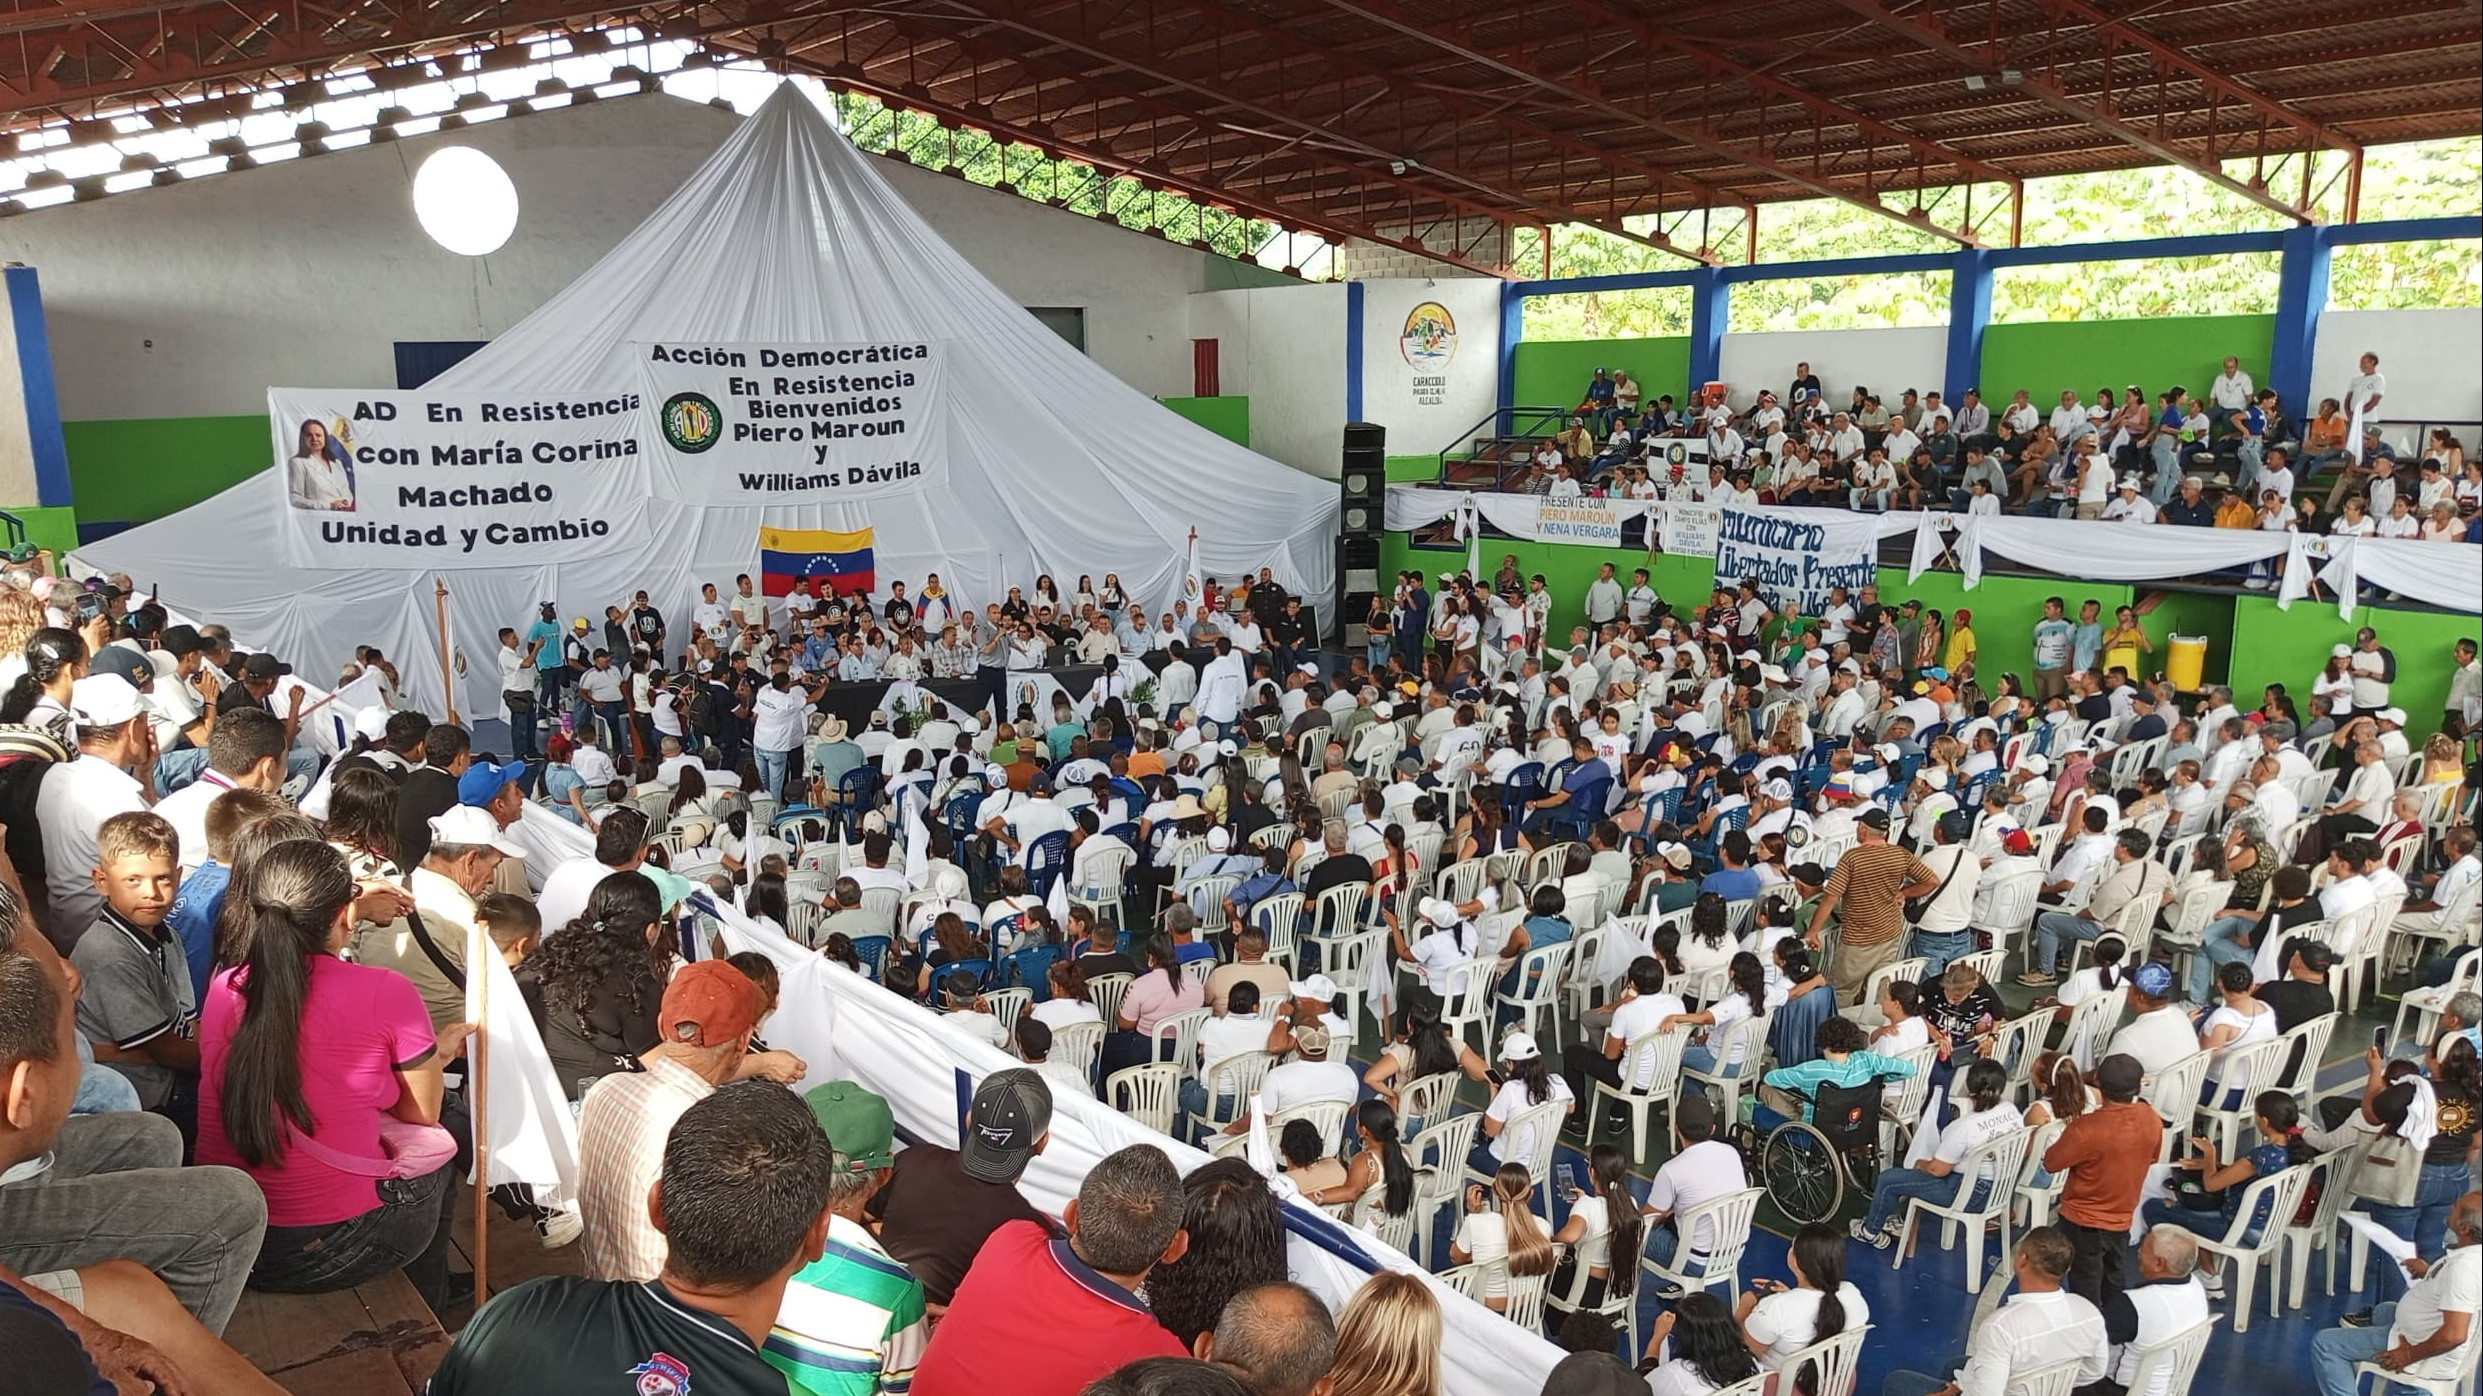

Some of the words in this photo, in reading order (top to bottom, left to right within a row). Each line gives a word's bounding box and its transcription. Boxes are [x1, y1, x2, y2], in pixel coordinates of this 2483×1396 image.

[652, 344, 745, 368] Acción
[760, 342, 928, 368] Democrática
[730, 376, 760, 396] En
[774, 368, 915, 396] Resistencia
[354, 401, 397, 422] AD
[427, 403, 463, 423] En
[482, 394, 640, 423] Resistencia
[748, 396, 902, 419] Bienvenidos
[734, 422, 804, 442] Piero
[812, 419, 905, 440] Maroun
[357, 445, 420, 465] con
[432, 438, 523, 466] María
[532, 436, 638, 464] Corina
[814, 444, 828, 466] y
[738, 471, 840, 492] Williams
[848, 460, 921, 485] Dávila
[399, 480, 553, 508] Machado
[1541, 495, 1585, 509] PRESENTE
[1588, 498, 1607, 510] CON
[1540, 508, 1567, 521] PIERO
[1570, 510, 1616, 525] MAROUN
[322, 520, 448, 547] Unidad
[461, 527, 478, 553] y
[486, 518, 609, 545] Cambio
[1536, 522, 1543, 534] Y
[1544, 522, 1570, 535] NENA
[1573, 524, 1620, 539] VERGARA
[1715, 541, 1799, 588] Libertador
[1804, 554, 1877, 590] Presente
